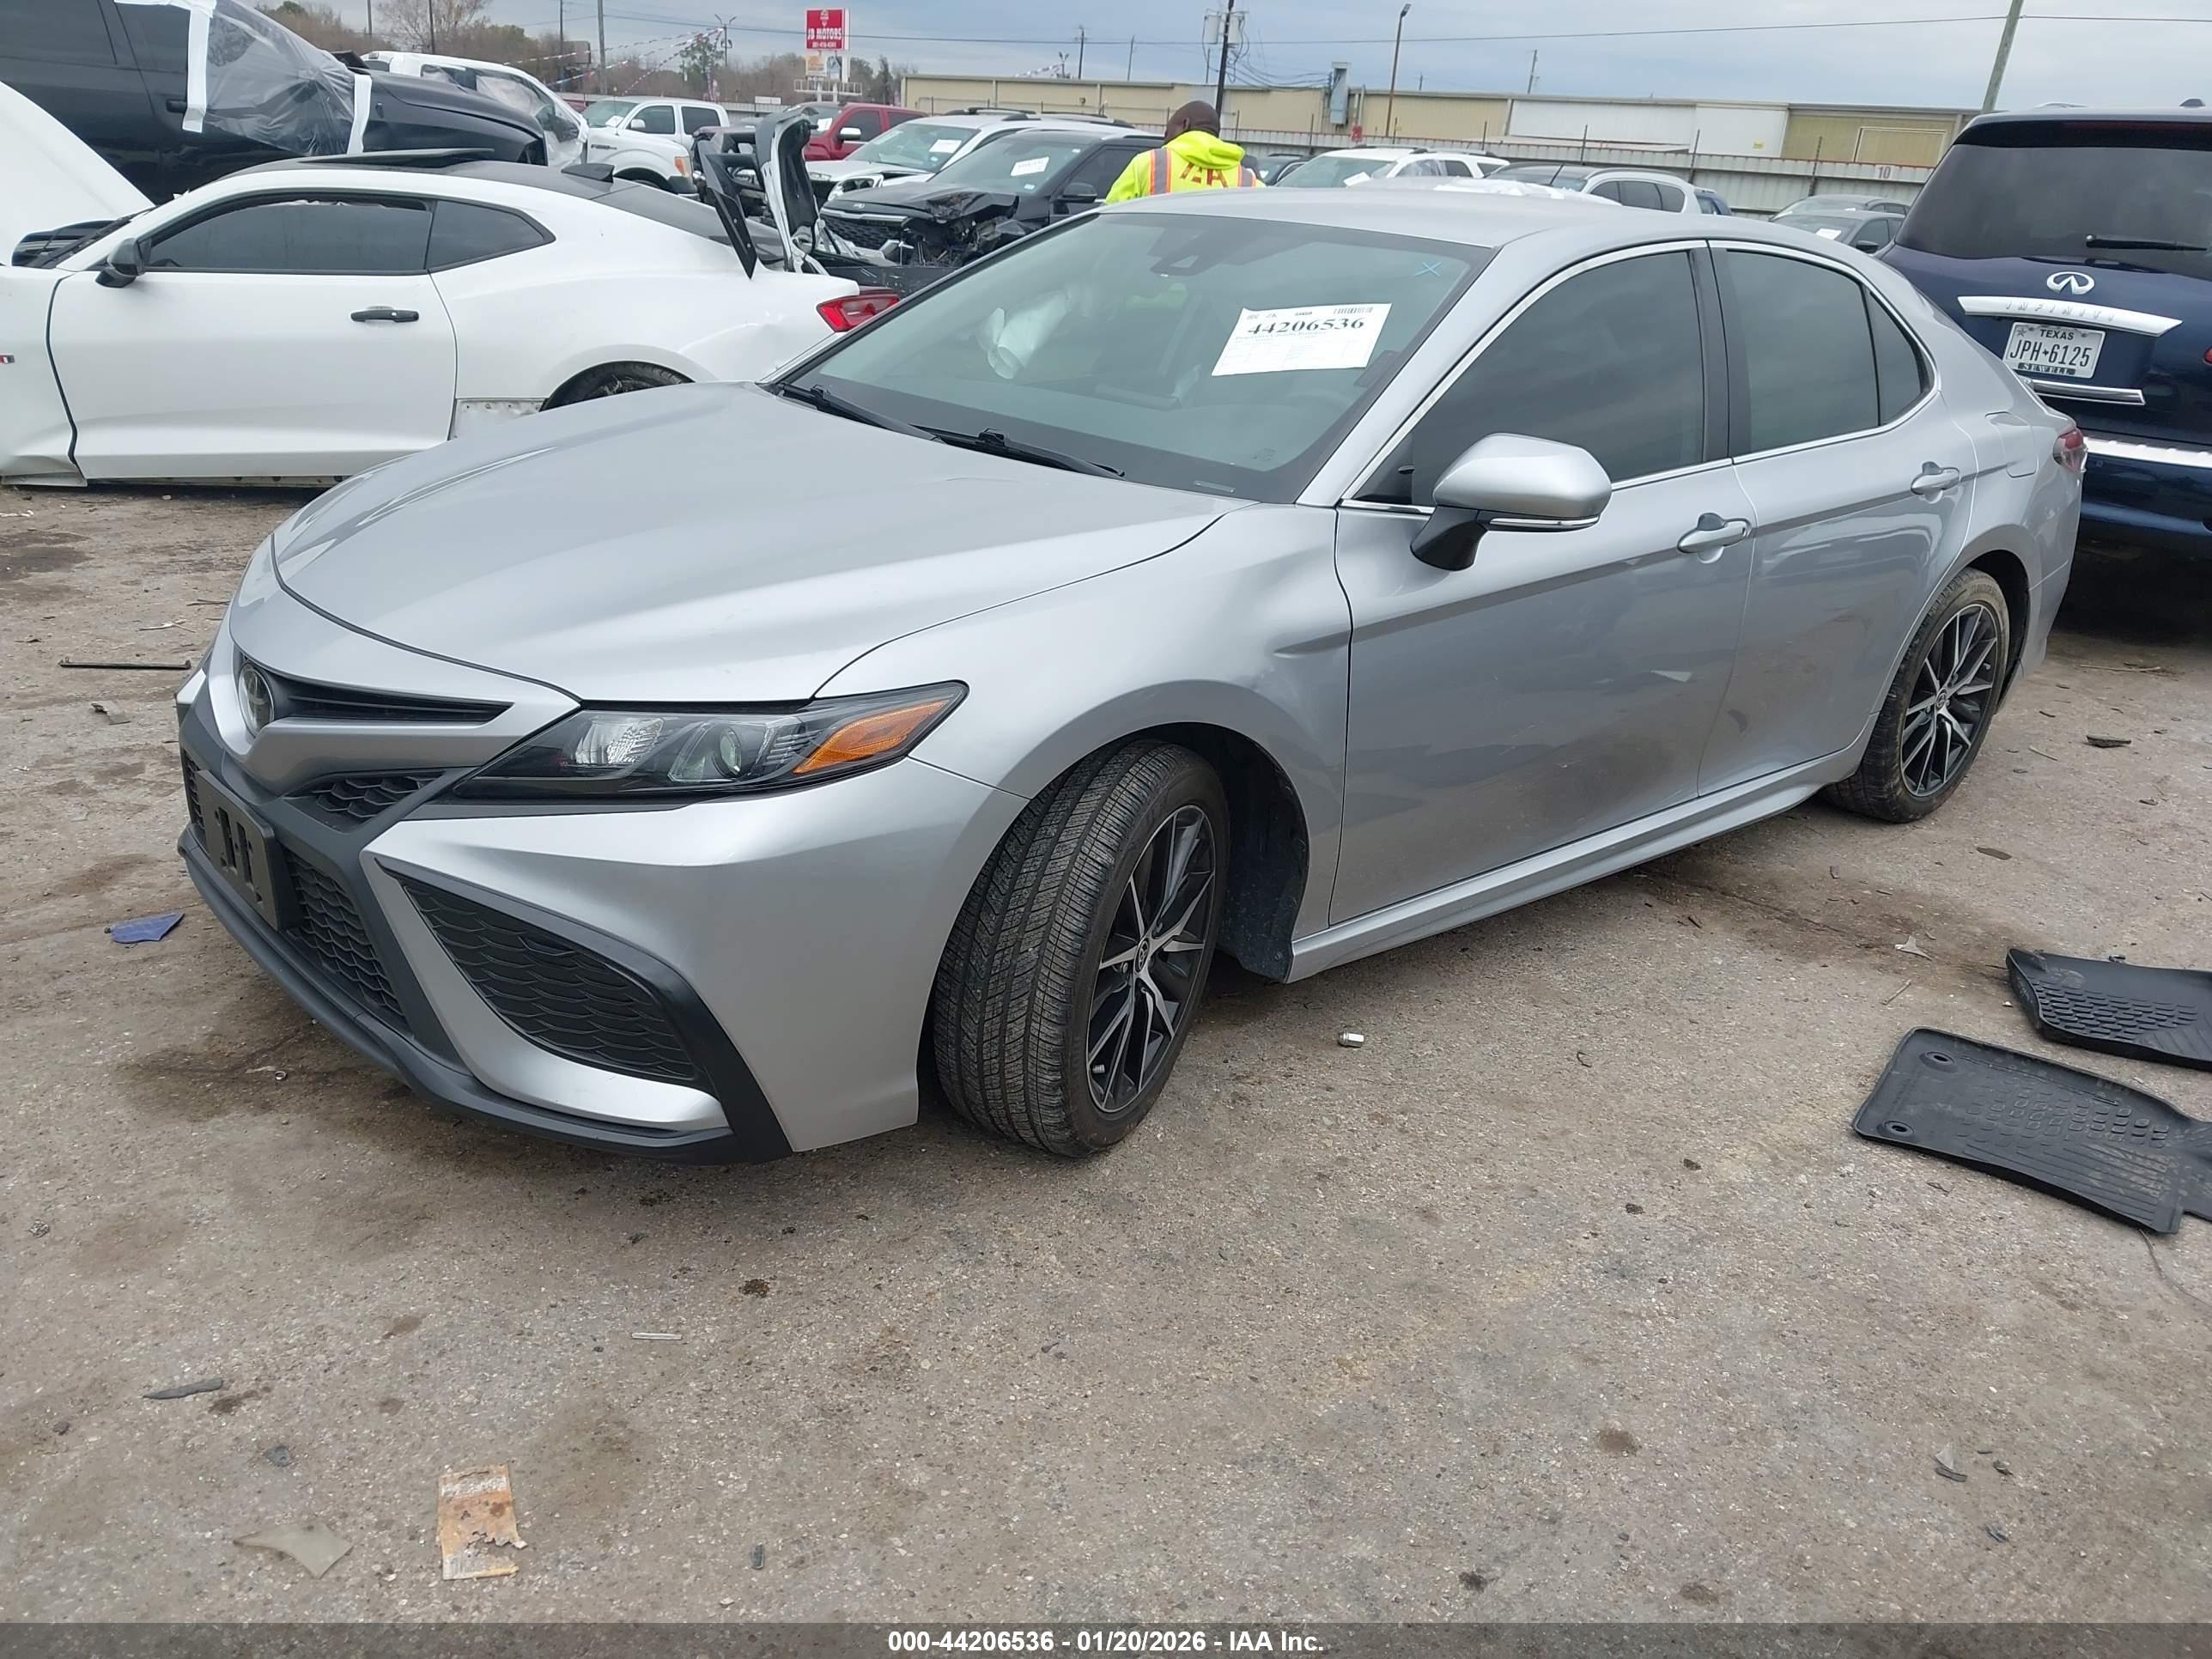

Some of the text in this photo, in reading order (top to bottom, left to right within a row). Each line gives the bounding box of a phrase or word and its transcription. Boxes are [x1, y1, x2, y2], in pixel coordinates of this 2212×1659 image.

[816, 27, 842, 40] MOTORS
[1878, 166, 1892, 179] 10
[2005, 301, 2116, 322] INFINITI
[1248, 317, 1364, 335] 44206536
[2039, 329, 2075, 341] TEXAS
